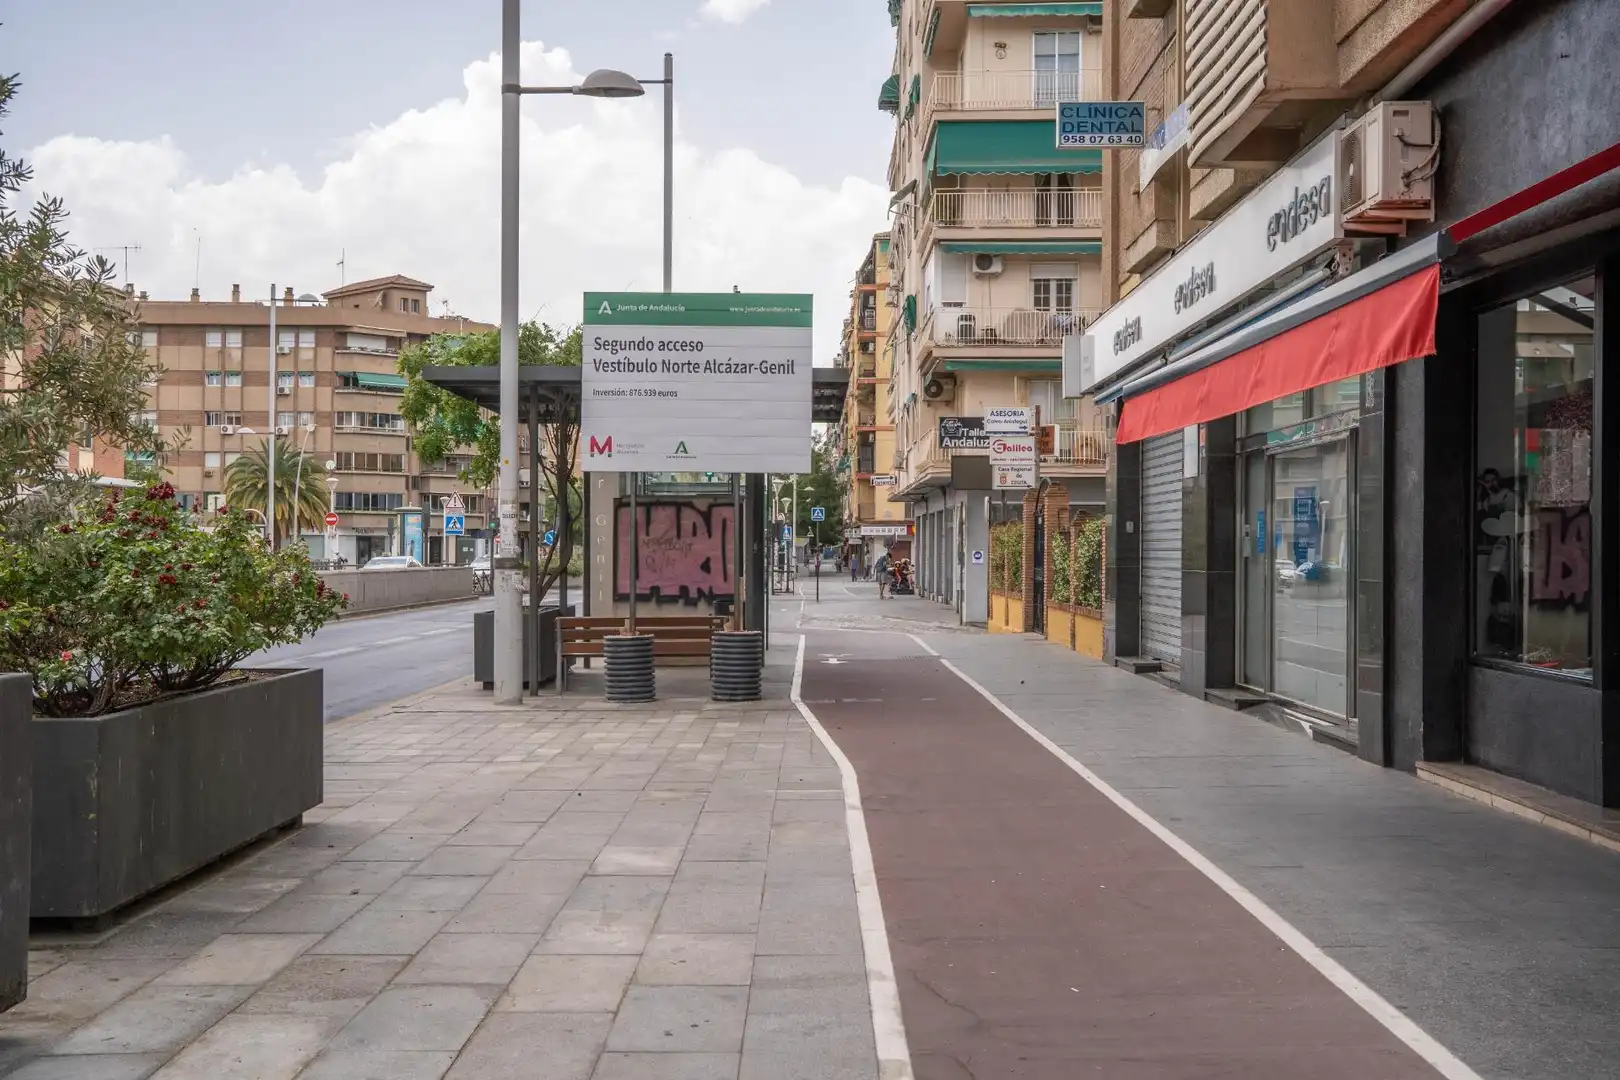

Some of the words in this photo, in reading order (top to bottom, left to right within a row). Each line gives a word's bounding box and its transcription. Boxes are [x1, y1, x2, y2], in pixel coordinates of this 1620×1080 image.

[1061, 103, 1142, 118] CLÍNICA
[1062, 121, 1142, 133] DENTAL
[1063, 135, 1085, 143] 958
[1089, 135, 1103, 143] 07
[1108, 135, 1122, 143] 63
[1126, 135, 1141, 143] 40
[1266, 174, 1332, 252] endesa
[1174, 261, 1217, 315] endesa
[616, 303, 637, 312] Junta
[638, 303, 648, 312] de
[649, 303, 685, 312] Andalucía
[1112, 314, 1143, 356] endesa
[593, 336, 654, 354] Segundo
[658, 339, 704, 352] acceso
[593, 357, 658, 374] Vestíbulo
[661, 359, 700, 374] Norte
[703, 357, 795, 375] Alcázar-Genil
[592, 388, 628, 397] Inversión:
[628, 388, 657, 397] 876.939
[658, 389, 678, 398] euros
[962, 428, 987, 437] Talle
[942, 437, 990, 447] Andaluz
[992, 439, 1033, 455] Galilea
